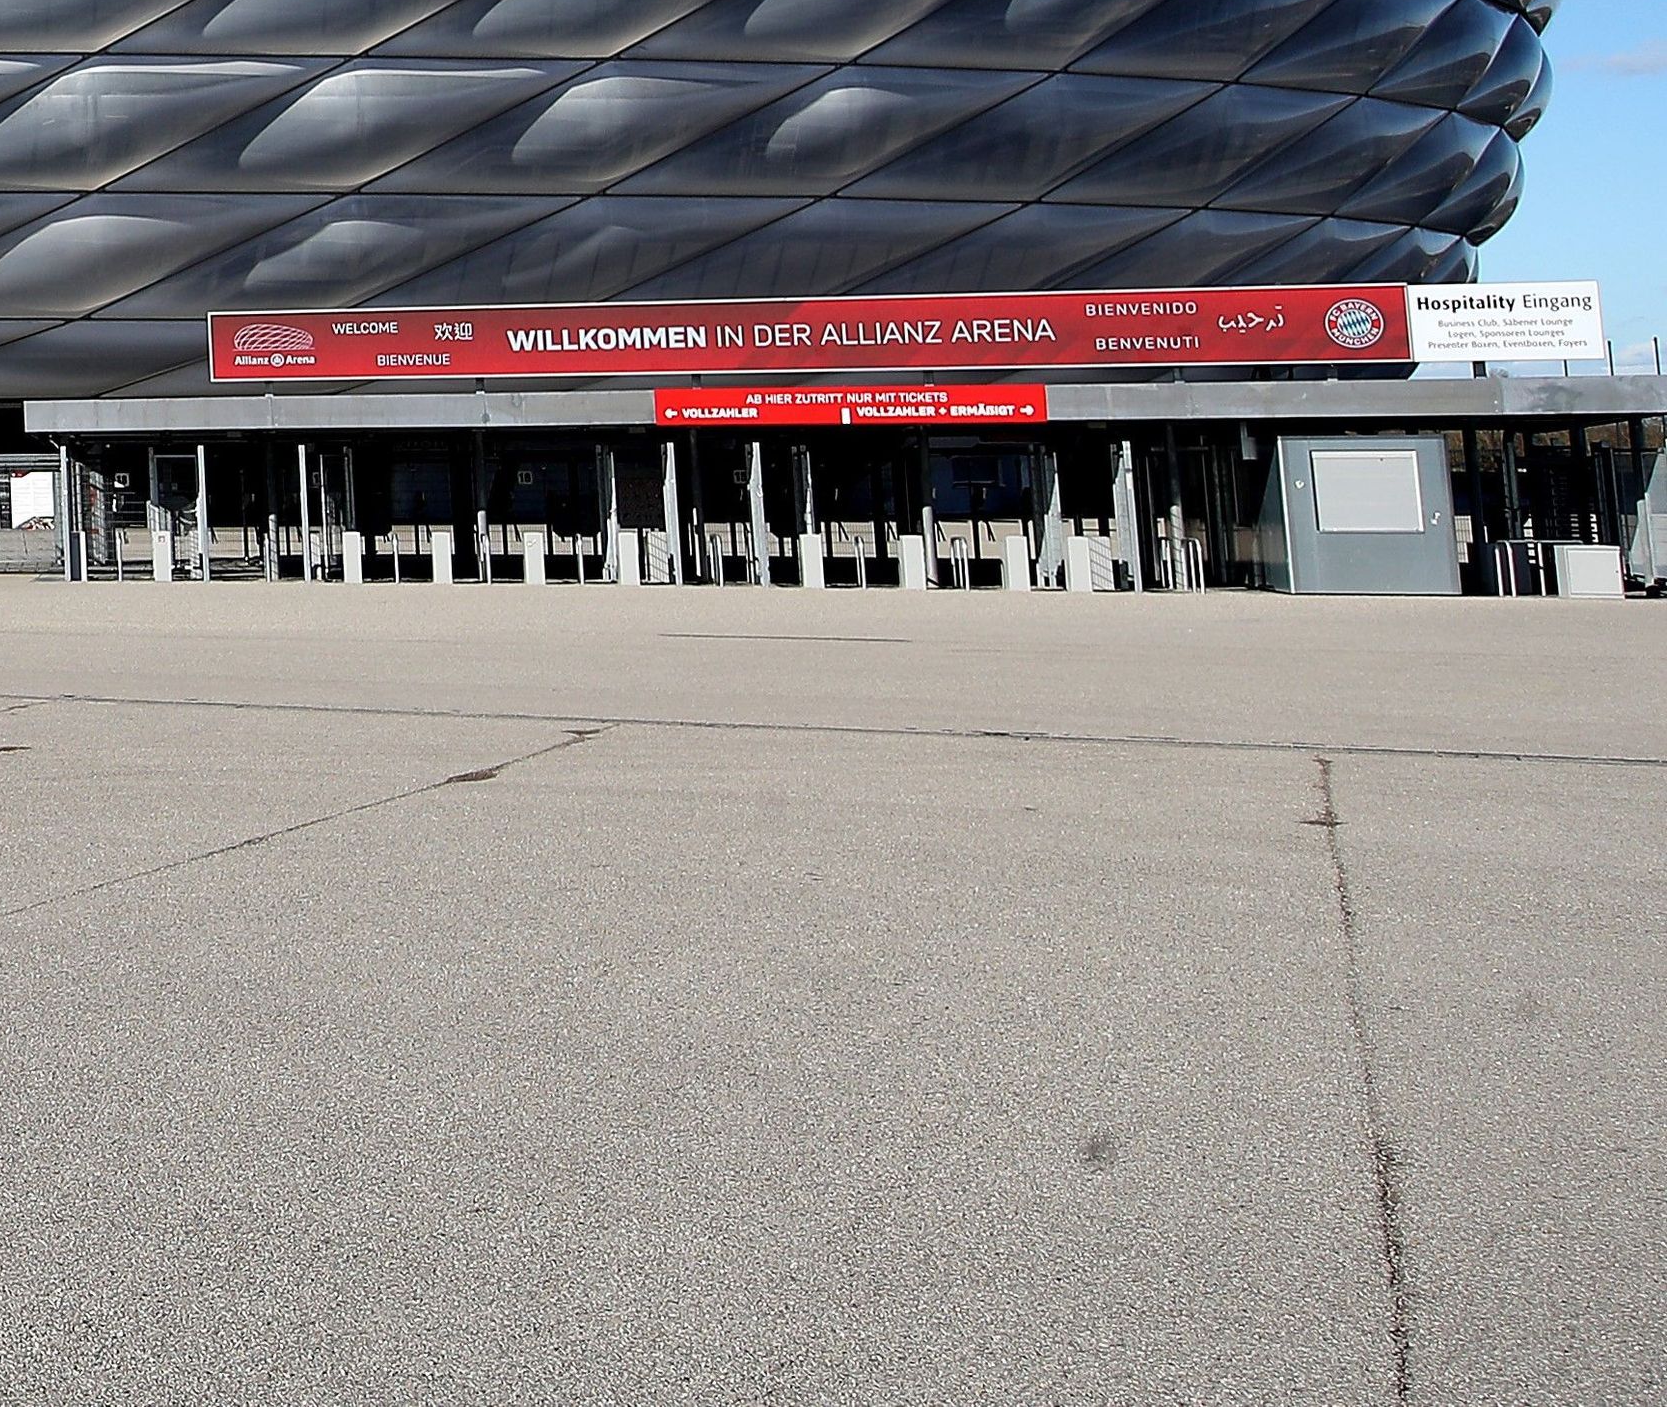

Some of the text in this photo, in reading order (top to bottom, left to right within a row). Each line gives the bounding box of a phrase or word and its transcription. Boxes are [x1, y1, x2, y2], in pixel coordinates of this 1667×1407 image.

[1085, 302, 1197, 316] BIENVENIDO
[1417, 294, 1592, 312] Hospitality Eingang
[1329, 302, 1378, 321] FC BAYERN
[1218, 305, 1284, 333] ترحيب
[1540, 318, 1573, 326] Lounge
[332, 322, 398, 334] WELCOME
[434, 322, 473, 341] 欢迎
[1479, 330, 1526, 338] Sponsoren
[1528, 329, 1565, 337] Lounges
[506, 319, 1056, 351] WILLKOMMEN IN DER ALLIANZ ARENA
[1096, 337, 1200, 350] BENVENUTI
[1558, 339, 1588, 348] Foyers
[234, 355, 316, 366] Allianz Arena
[377, 354, 450, 366] BIENVENUE
[746, 392, 948, 404] AB HIER ZUTRITT NUR MIT TICKETS
[682, 407, 759, 418] VOLLZAHLER
[856, 406, 936, 417] VOLLZAHLER
